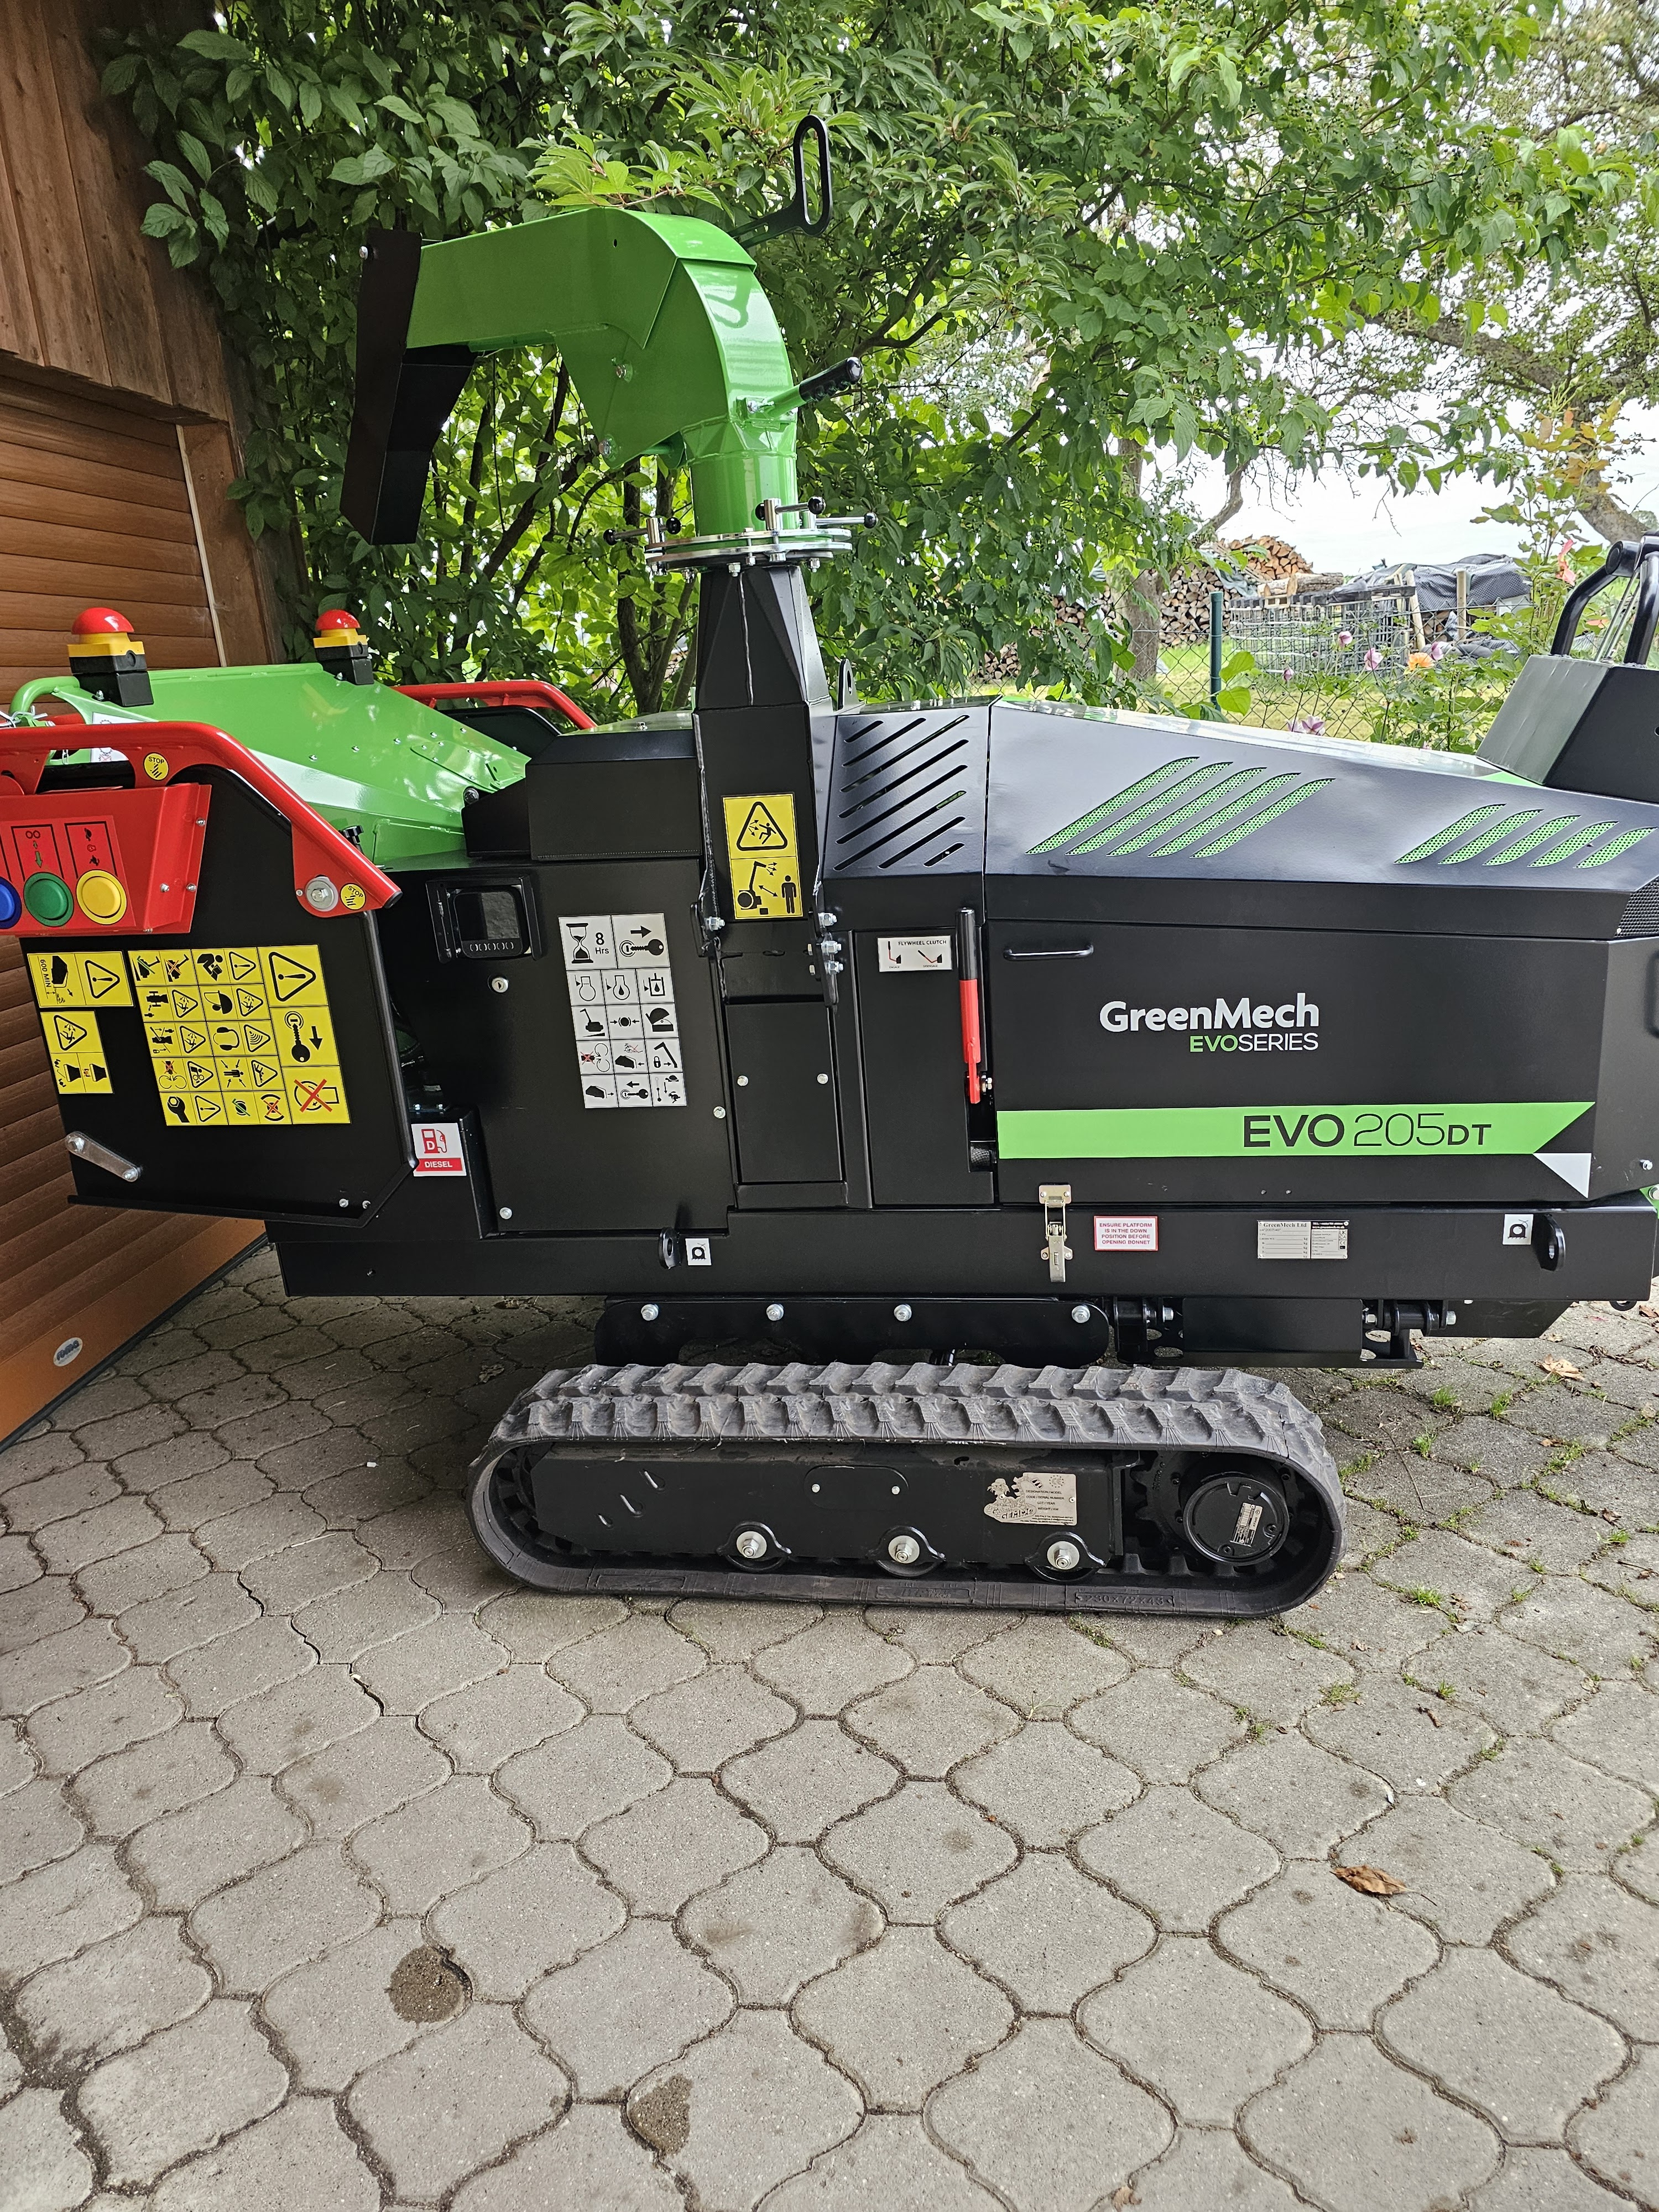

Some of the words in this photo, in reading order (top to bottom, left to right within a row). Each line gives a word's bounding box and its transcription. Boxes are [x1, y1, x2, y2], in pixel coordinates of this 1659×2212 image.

[348, 885, 364, 898] STOP
[596, 932, 604, 945] 8
[1099, 993, 1319, 1032] GreenMech
[1243, 1114, 1344, 1148] EVO
[426, 1140, 435, 1150] D
